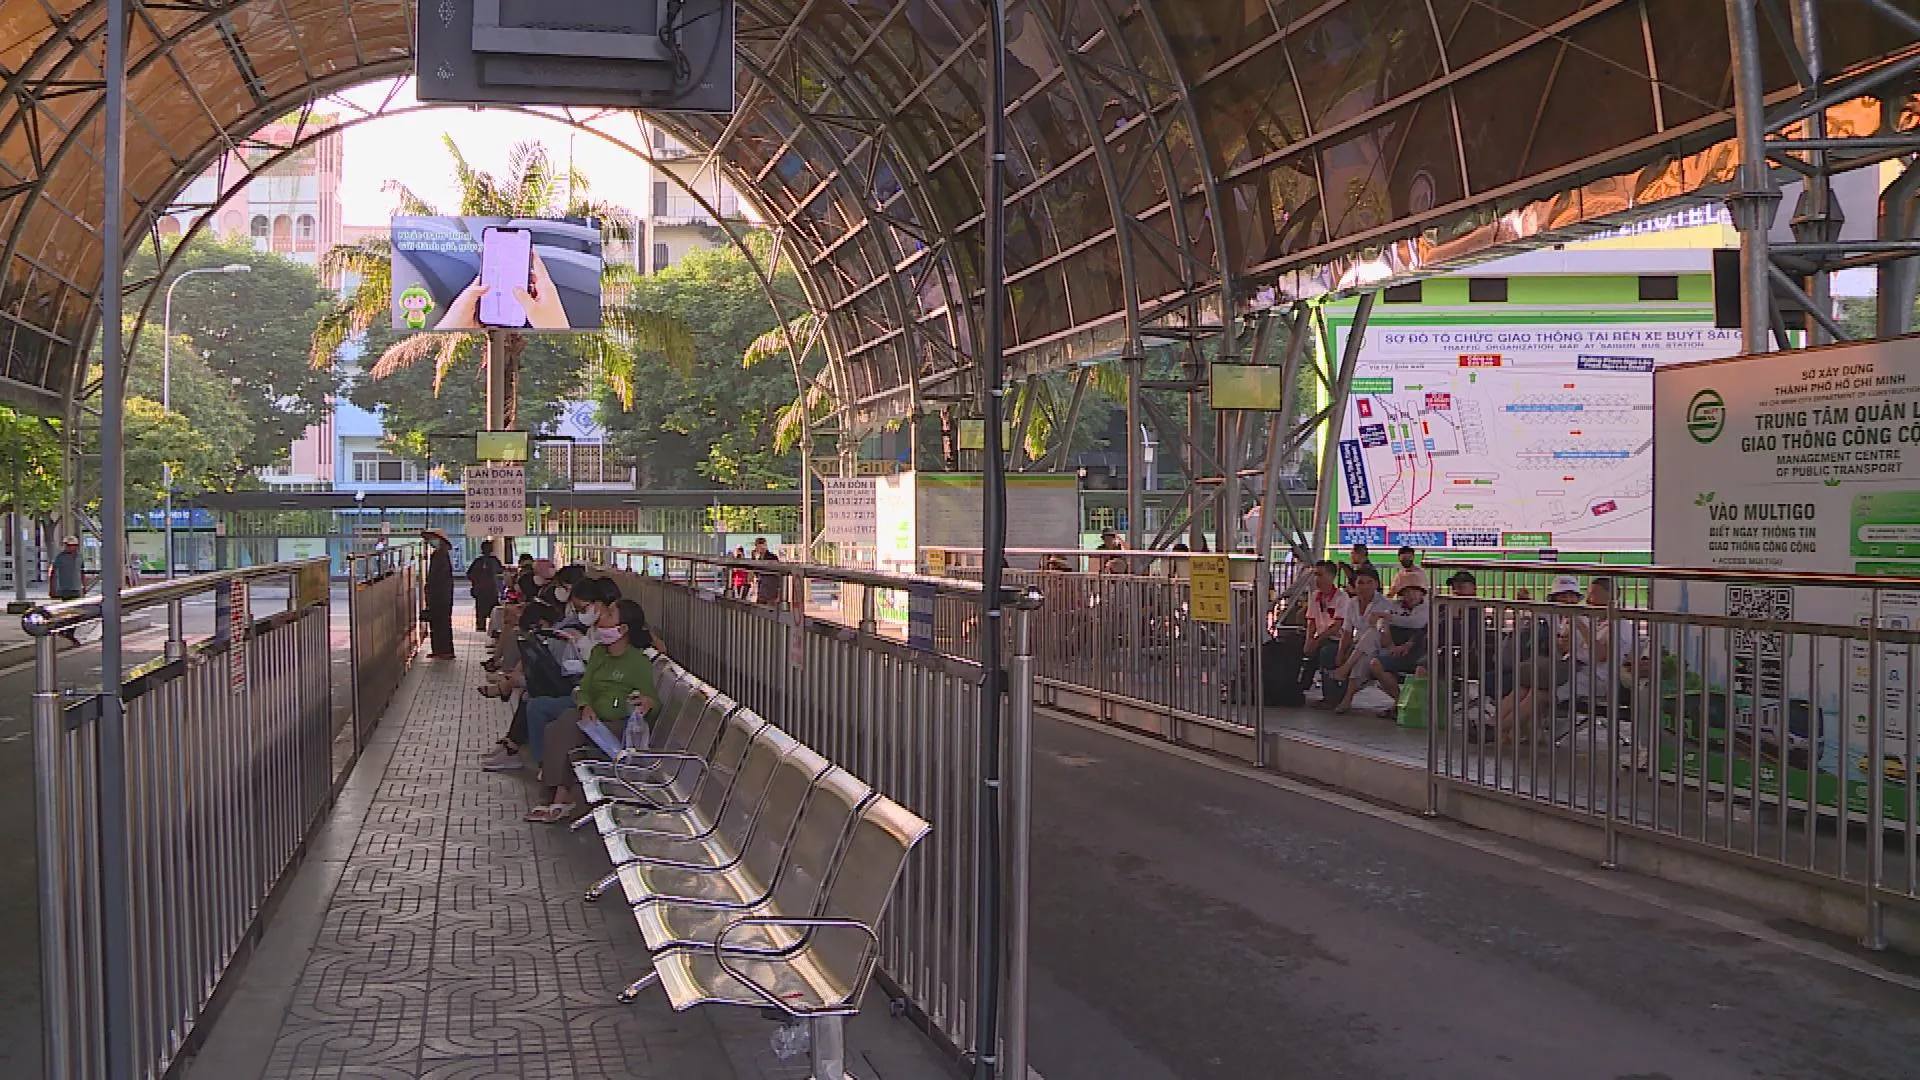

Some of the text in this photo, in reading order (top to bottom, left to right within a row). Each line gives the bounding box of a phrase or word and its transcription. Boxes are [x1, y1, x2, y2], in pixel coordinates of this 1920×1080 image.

[1497, 333, 1531, 343] GIAO
[1536, 330, 1583, 342] THÔNG
[1645, 331, 1663, 341] XE
[1876, 374, 1906, 387] MINH
[1755, 410, 1807, 430] TRUNG
[1813, 405, 1848, 426] TÂM
[1855, 399, 1906, 423] QUẢN
[1741, 435, 1776, 453] GIAO
[1782, 428, 1836, 450] THÔNG
[1842, 425, 1891, 447] CÔNG
[1776, 449, 1901, 465] MANAGEMENT CENTRE
[1776, 461, 1903, 477] OF PUBLIC TRANSPORT
[1709, 501, 1816, 521] VÀO MULTIGO
[1709, 524, 1817, 538] BIẾT NGAY THÔNG TIN
[1709, 539, 1816, 554] GIAO THÔNG CÔNG CỘNG
